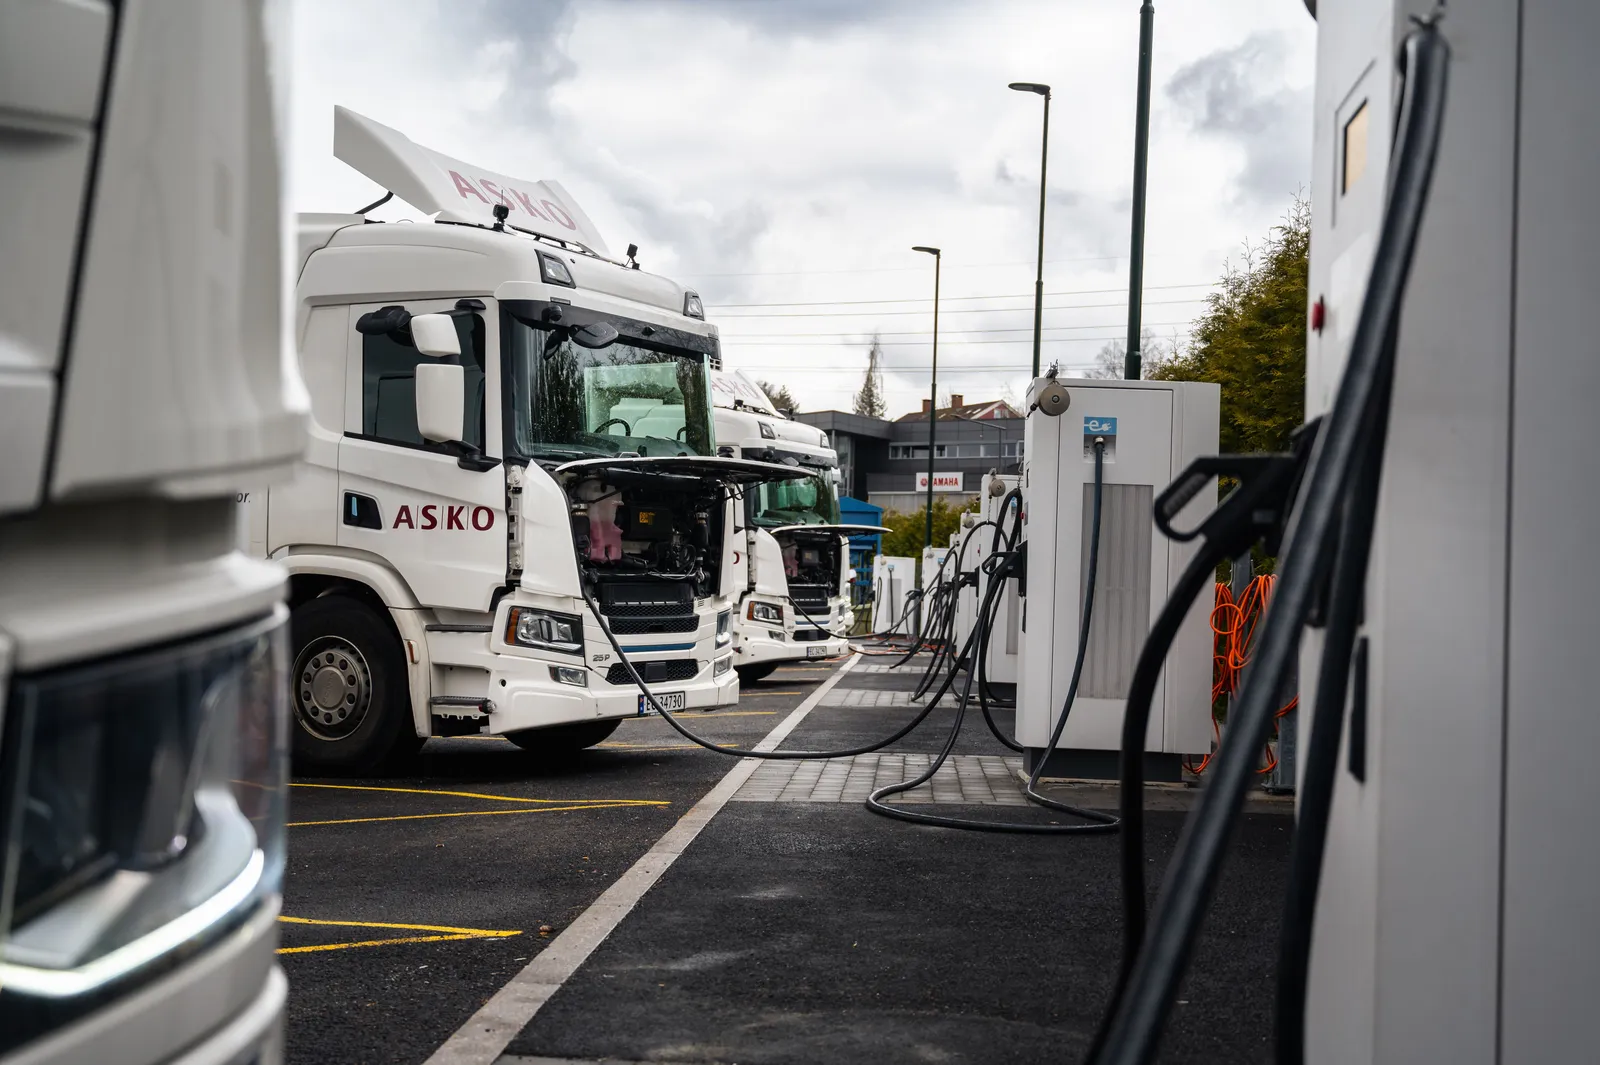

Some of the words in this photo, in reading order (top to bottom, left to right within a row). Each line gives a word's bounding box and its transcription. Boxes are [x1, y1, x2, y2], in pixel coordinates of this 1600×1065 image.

[448, 170, 577, 231] ASKO
[931, 477, 959, 487] AMAHA
[392, 505, 495, 531] ASKO
